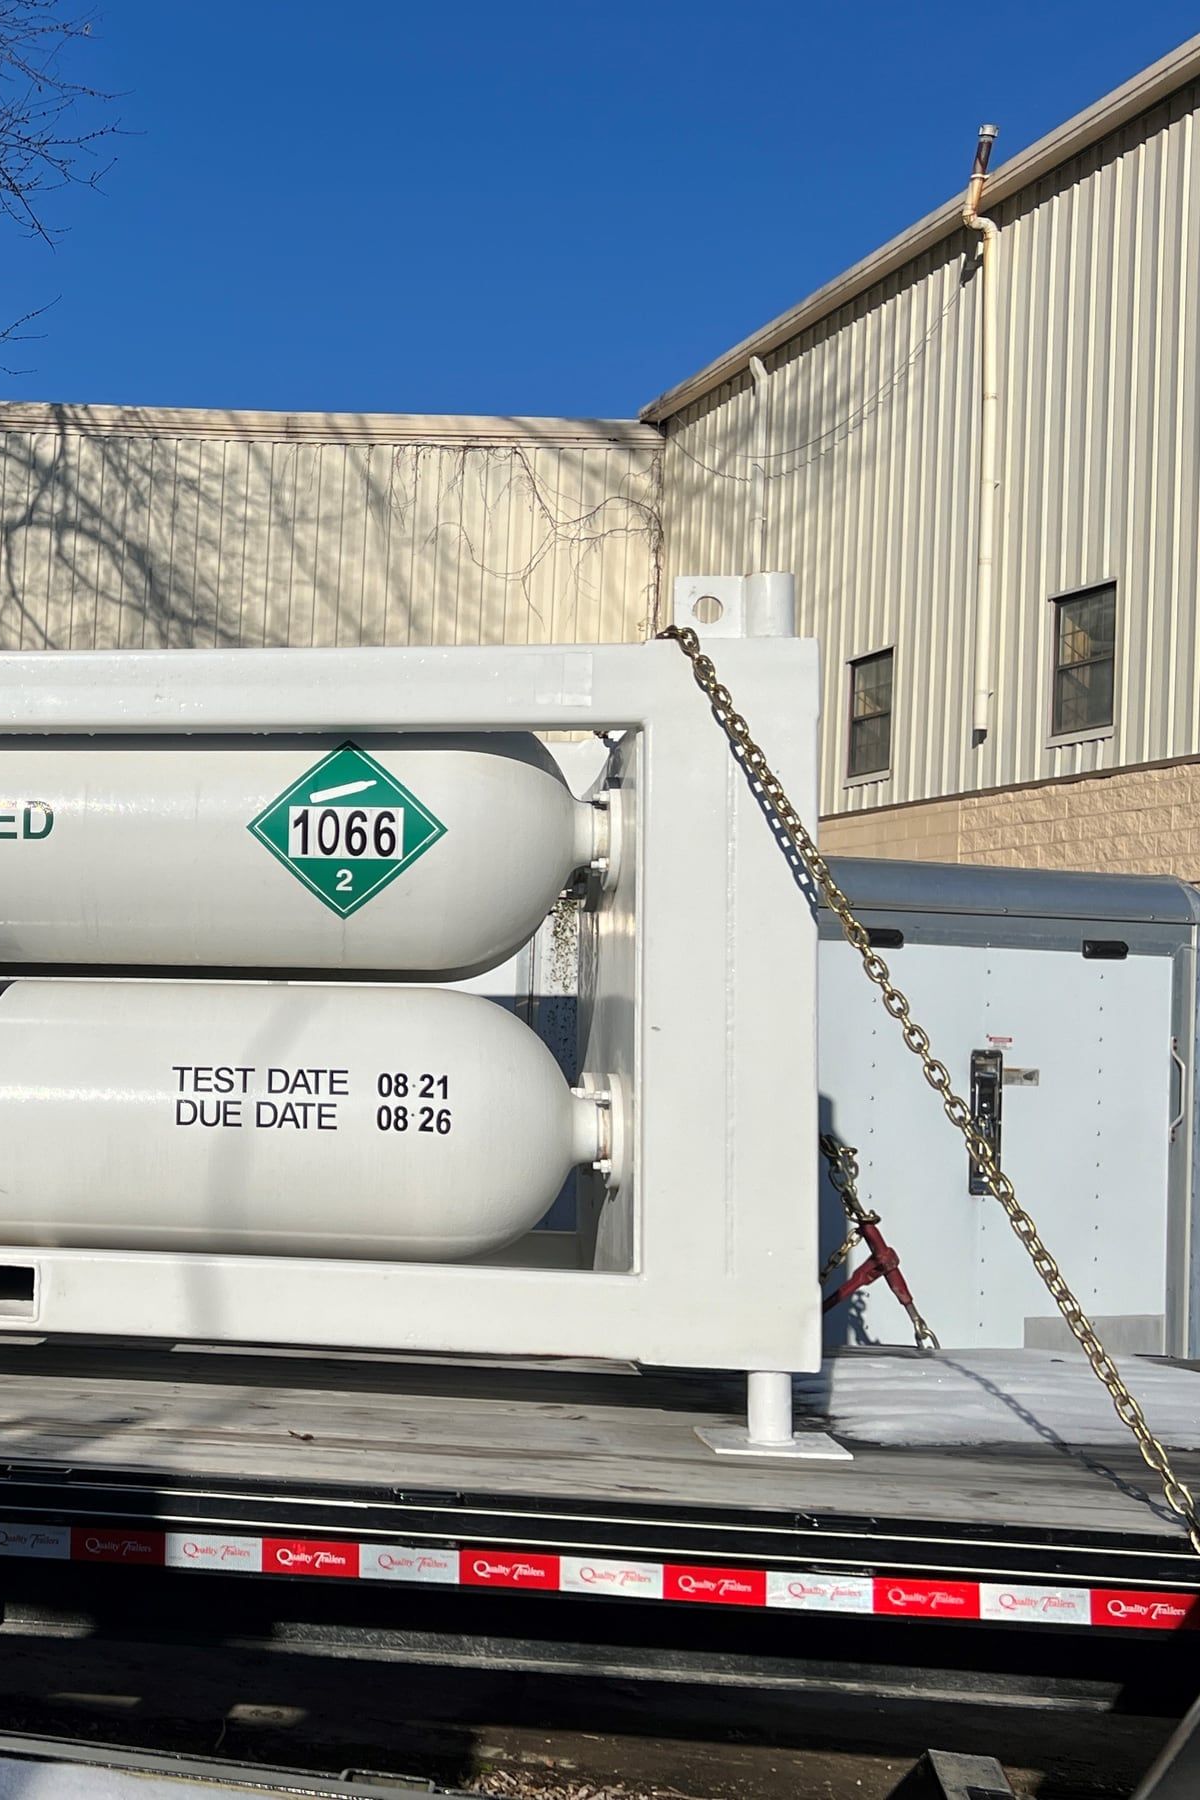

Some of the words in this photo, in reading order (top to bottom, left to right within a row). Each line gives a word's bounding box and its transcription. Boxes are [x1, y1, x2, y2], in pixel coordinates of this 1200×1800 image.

[293, 808, 396, 857] 1066
[335, 869, 353, 891] 2
[172, 1066, 255, 1093] TEST
[267, 1068, 349, 1095] DATE
[175, 1099, 242, 1127] DUE
[256, 1101, 337, 1130] DATE
[29, 1533, 59, 1548] Trailers
[85, 1537, 119, 1553] Quality
[121, 1540, 152, 1556] Trailers
[183, 1542, 217, 1559] Quality
[220, 1545, 250, 1560] Trailers
[276, 1548, 312, 1566] Quality
[313, 1551, 346, 1569] Trailers
[377, 1553, 413, 1570] Quality
[414, 1556, 448, 1572] Trailers
[473, 1560, 511, 1578] Quality
[511, 1563, 545, 1581] Trailers
[579, 1566, 616, 1583] Quality
[618, 1570, 652, 1586] Trailers
[677, 1575, 716, 1593] Quality
[717, 1578, 752, 1596] Trailers
[787, 1582, 827, 1600] Quality
[829, 1583, 862, 1601] Trailers
[887, 1587, 927, 1606] Quality
[927, 1591, 965, 1609] Trailers
[999, 1593, 1038, 1612] Quality
[1039, 1596, 1075, 1613] Trailers
[1107, 1599, 1149, 1618] Quality
[1149, 1602, 1186, 1620] Trailers
